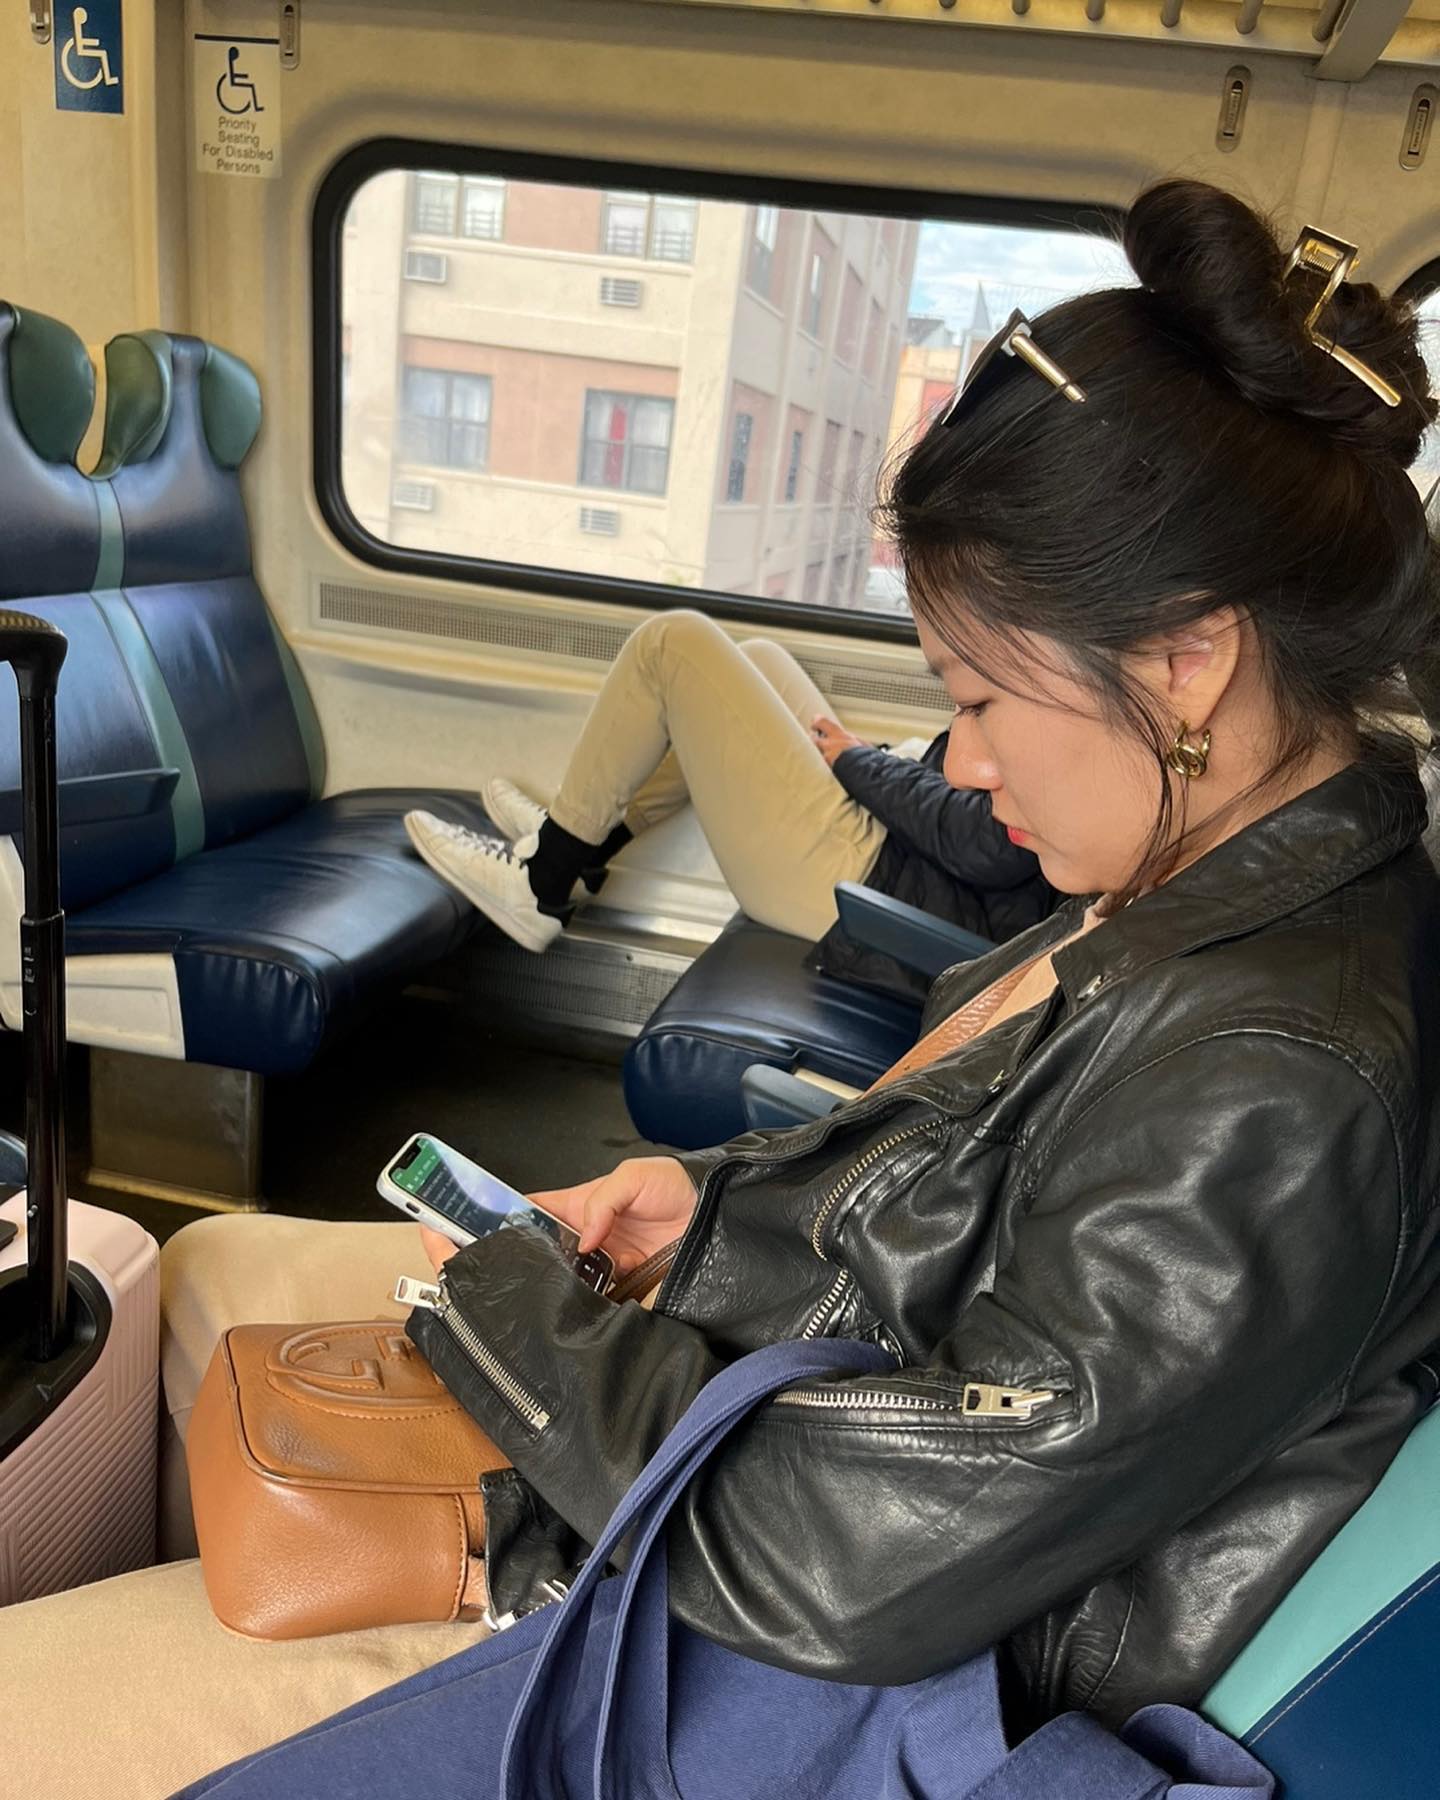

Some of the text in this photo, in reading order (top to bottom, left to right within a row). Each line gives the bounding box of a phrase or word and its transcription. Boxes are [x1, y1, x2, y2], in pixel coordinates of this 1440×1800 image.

[218, 116, 257, 133] Priority
[218, 130, 260, 148] Seating
[202, 142, 273, 161] For Disabled
[216, 158, 261, 174] Persons
